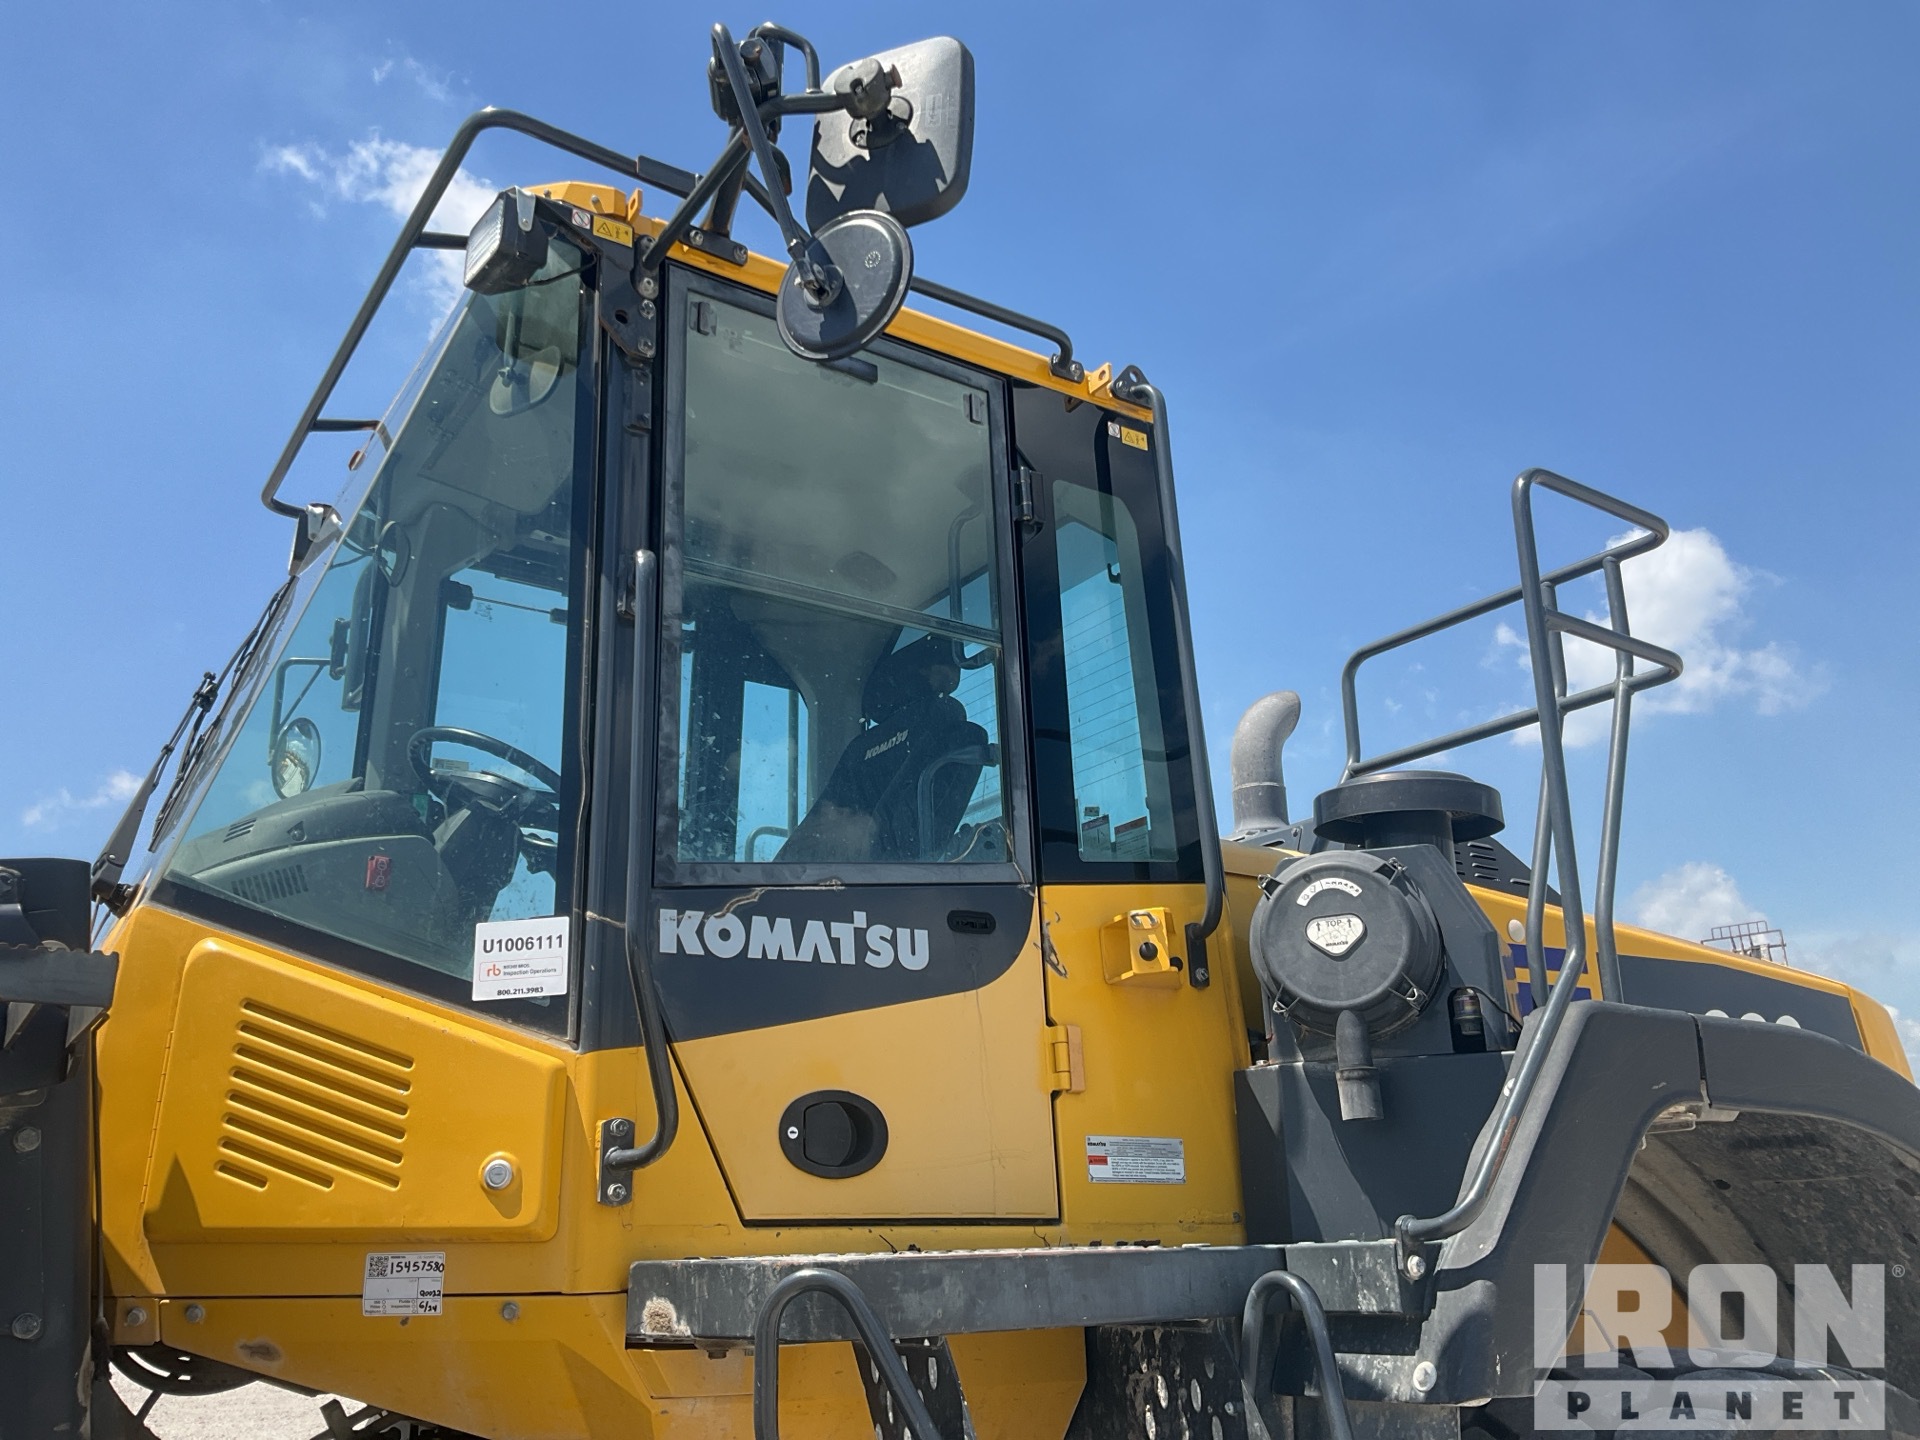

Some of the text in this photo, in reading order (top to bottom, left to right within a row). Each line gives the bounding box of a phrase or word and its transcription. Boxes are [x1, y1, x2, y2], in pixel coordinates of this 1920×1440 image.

[1325, 919, 1342, 928] TOP
[483, 934, 563, 954] U1006111
[659, 908, 929, 971] KOMATSU
[486, 963, 502, 977] rb
[503, 967, 557, 977] Inspection Operations
[497, 986, 544, 996] 800.211.3983
[390, 1260, 445, 1275] 15457580
